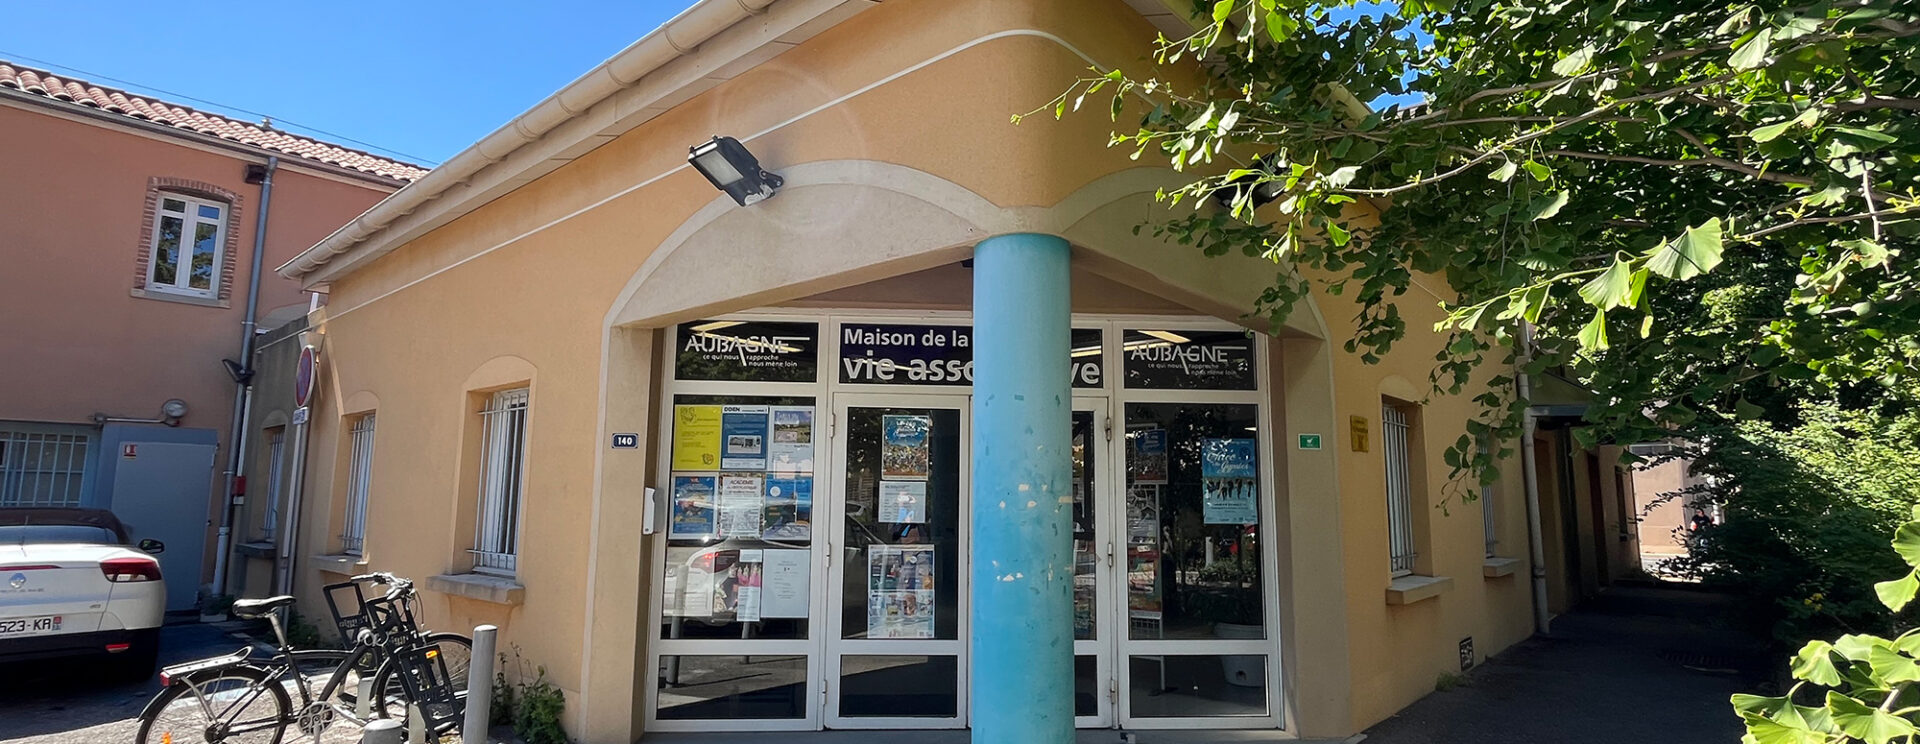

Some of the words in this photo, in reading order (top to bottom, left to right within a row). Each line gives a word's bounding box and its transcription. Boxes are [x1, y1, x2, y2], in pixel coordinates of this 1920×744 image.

[685, 331, 810, 361] AUBAGNE
[844, 328, 915, 346] Maison
[921, 329, 946, 347] de
[952, 330, 969, 347] la
[711, 353, 723, 361] qui
[843, 350, 896, 380] vie
[1131, 343, 1247, 370] AUBAGNE
[617, 436, 633, 446] 140
